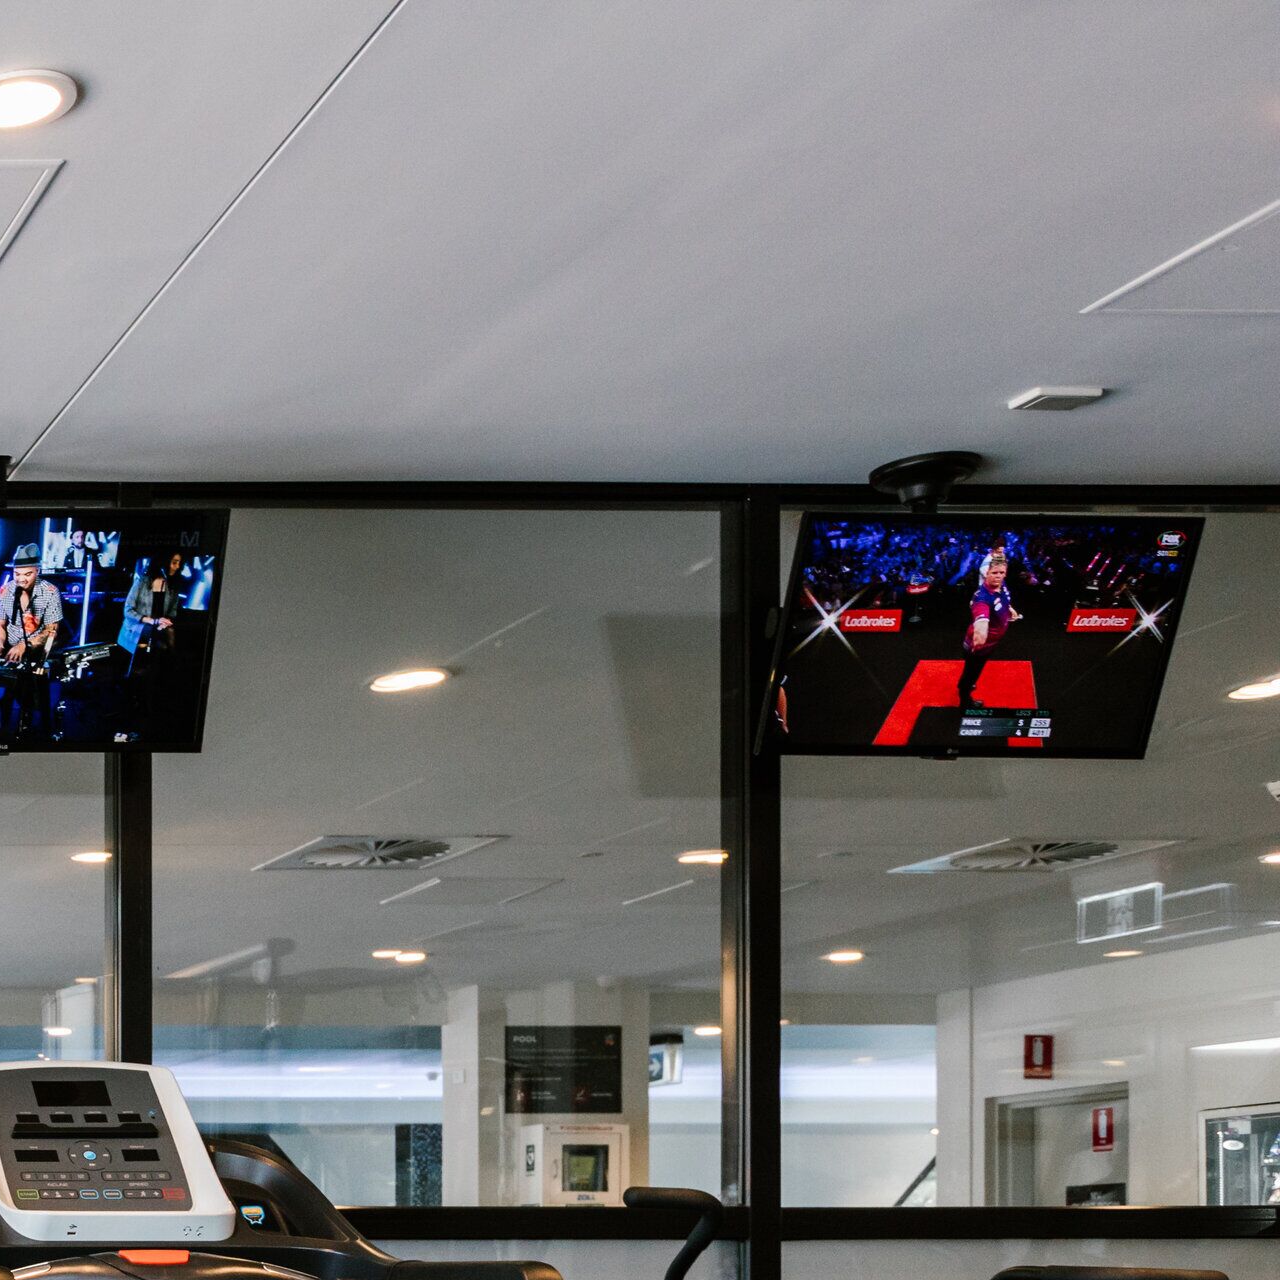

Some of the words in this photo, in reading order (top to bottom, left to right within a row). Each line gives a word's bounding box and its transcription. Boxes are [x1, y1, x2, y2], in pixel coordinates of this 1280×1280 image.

[844, 615, 897, 627] Ladbrokes
[1072, 615, 1130, 627] Ladbrokes
[513, 1035, 537, 1043] POOL
